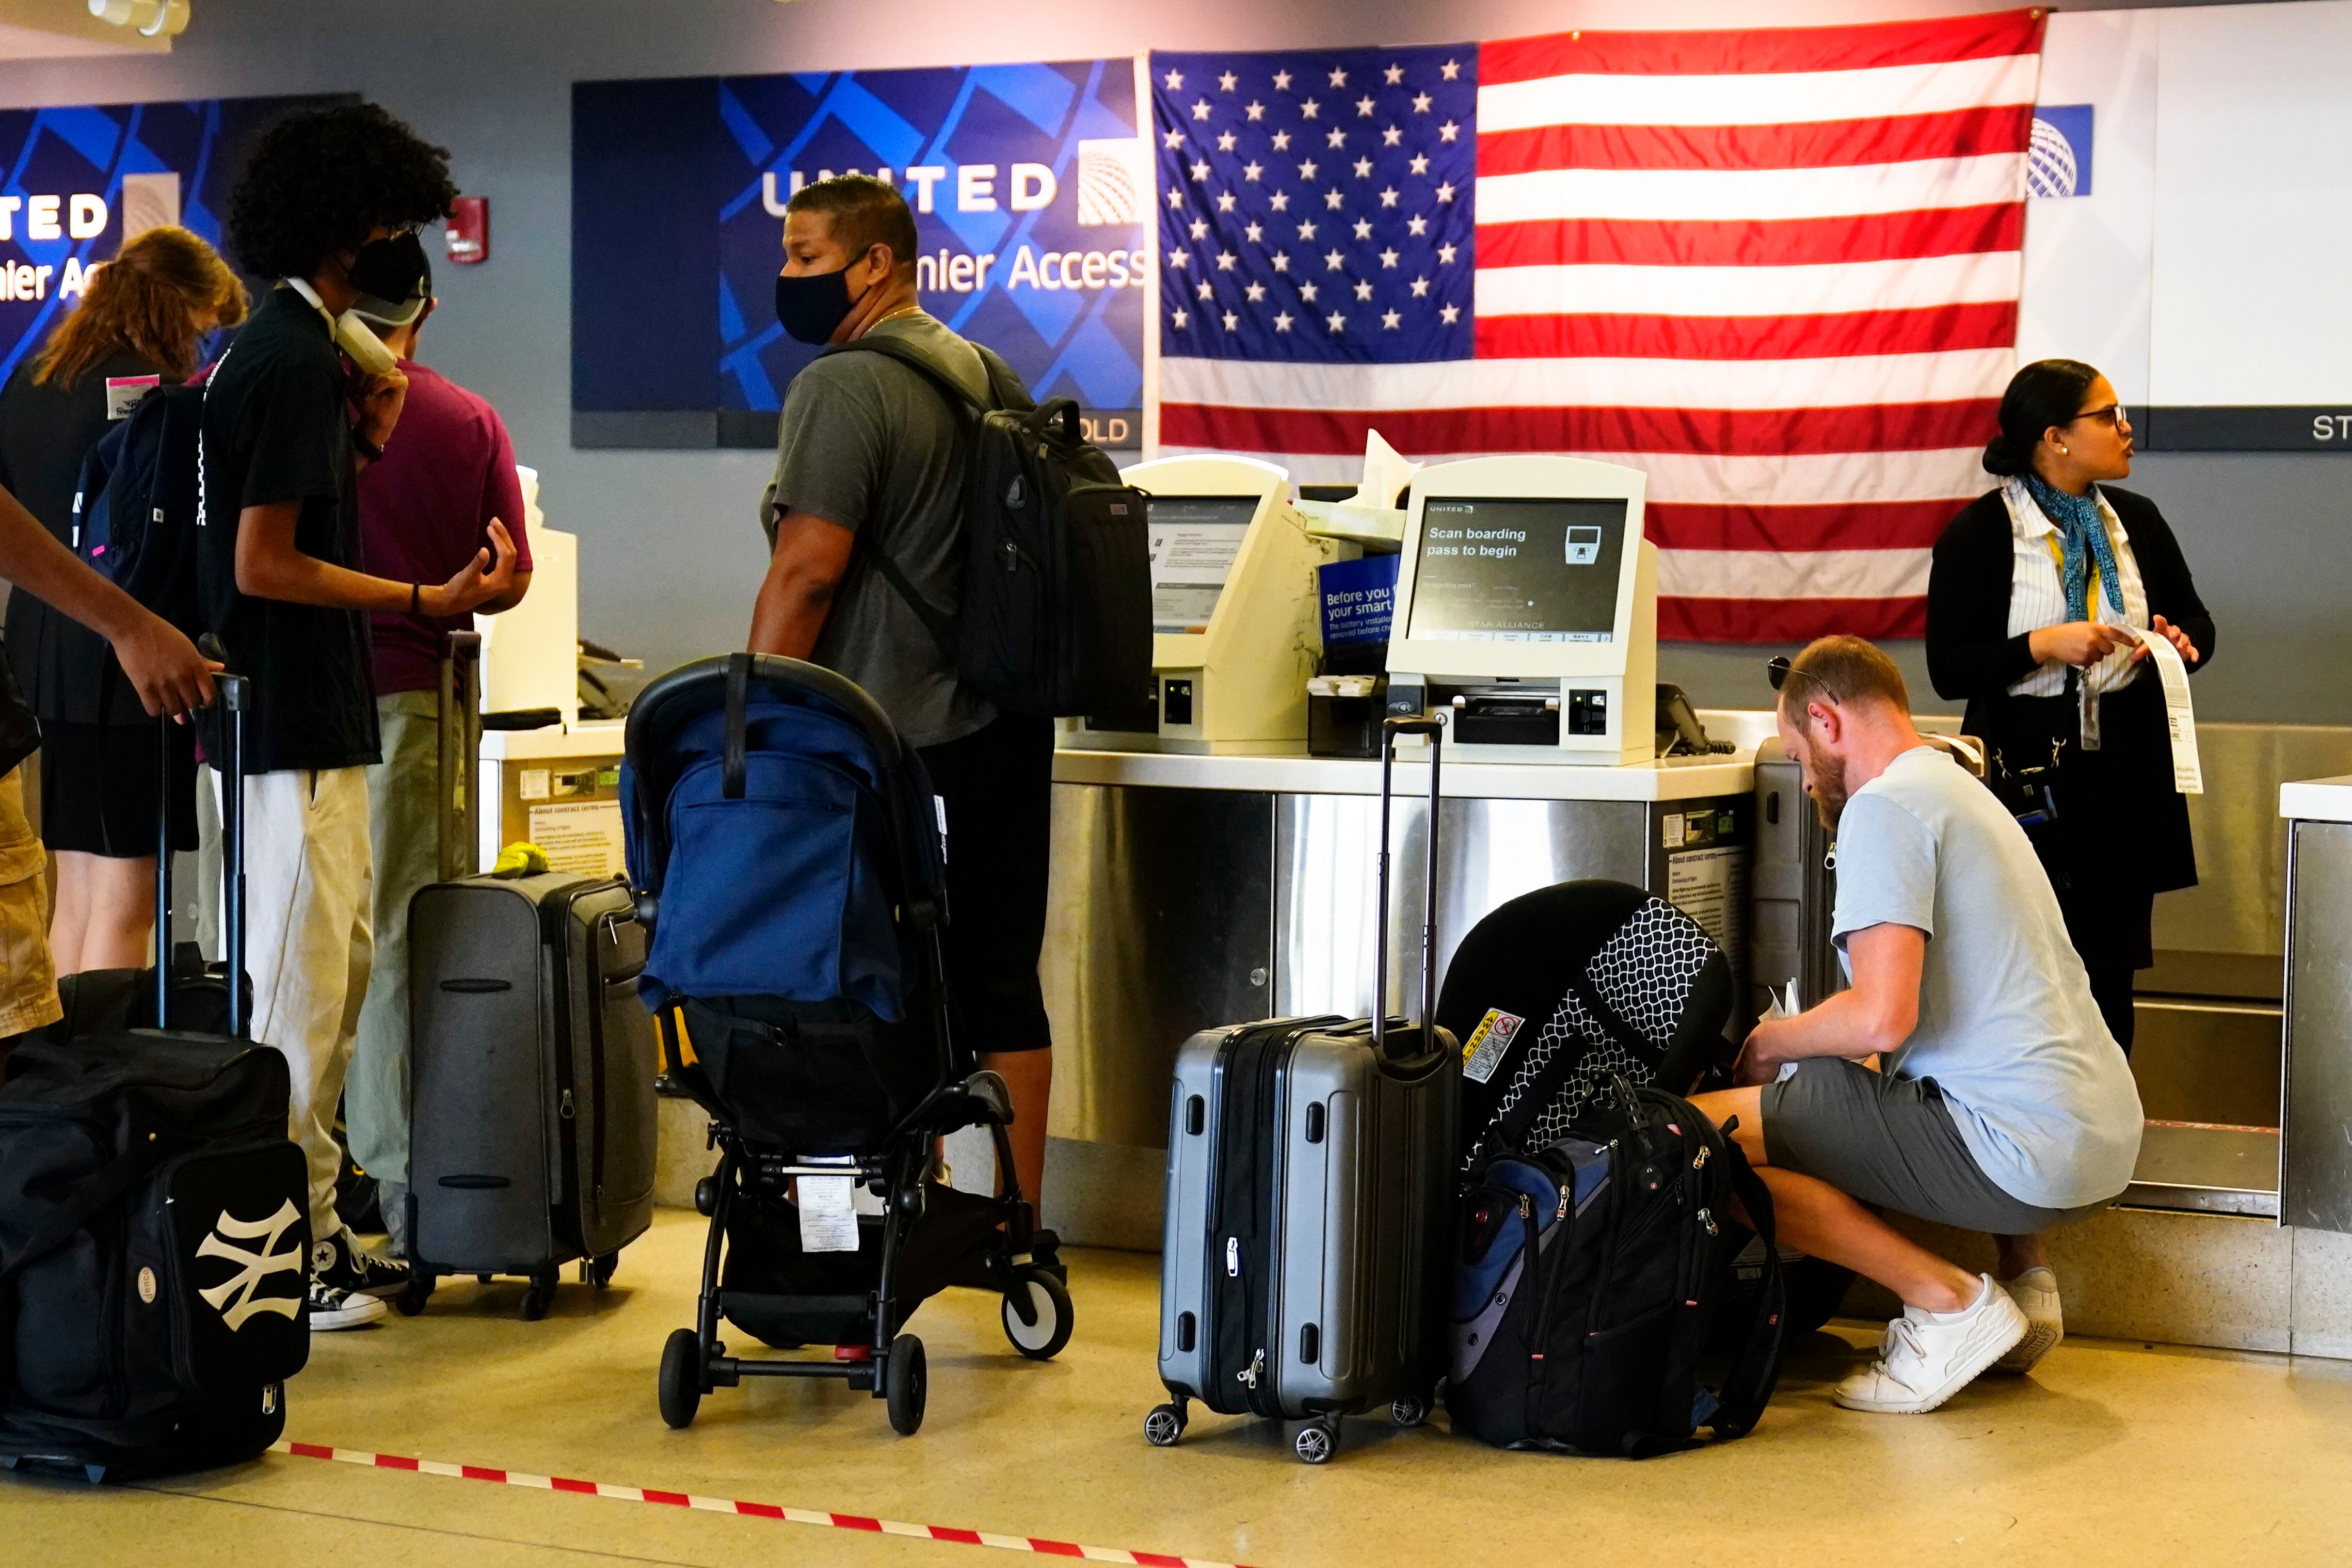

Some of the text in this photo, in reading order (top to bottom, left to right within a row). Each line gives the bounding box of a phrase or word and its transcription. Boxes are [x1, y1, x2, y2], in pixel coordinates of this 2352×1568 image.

[762, 163, 1057, 218] UTED
[1008, 245, 1146, 291] Access
[1429, 527, 1526, 542] Scan boarding
[1427, 545, 1517, 558] pass to begin
[1327, 591, 1363, 605] Before
[1365, 587, 1389, 601] you
[1329, 599, 1392, 621] your smart
[1357, 626, 1380, 635] before
[554, 805, 580, 813] contract
[1672, 856, 1685, 864] About
[1686, 854, 1703, 862] contract
